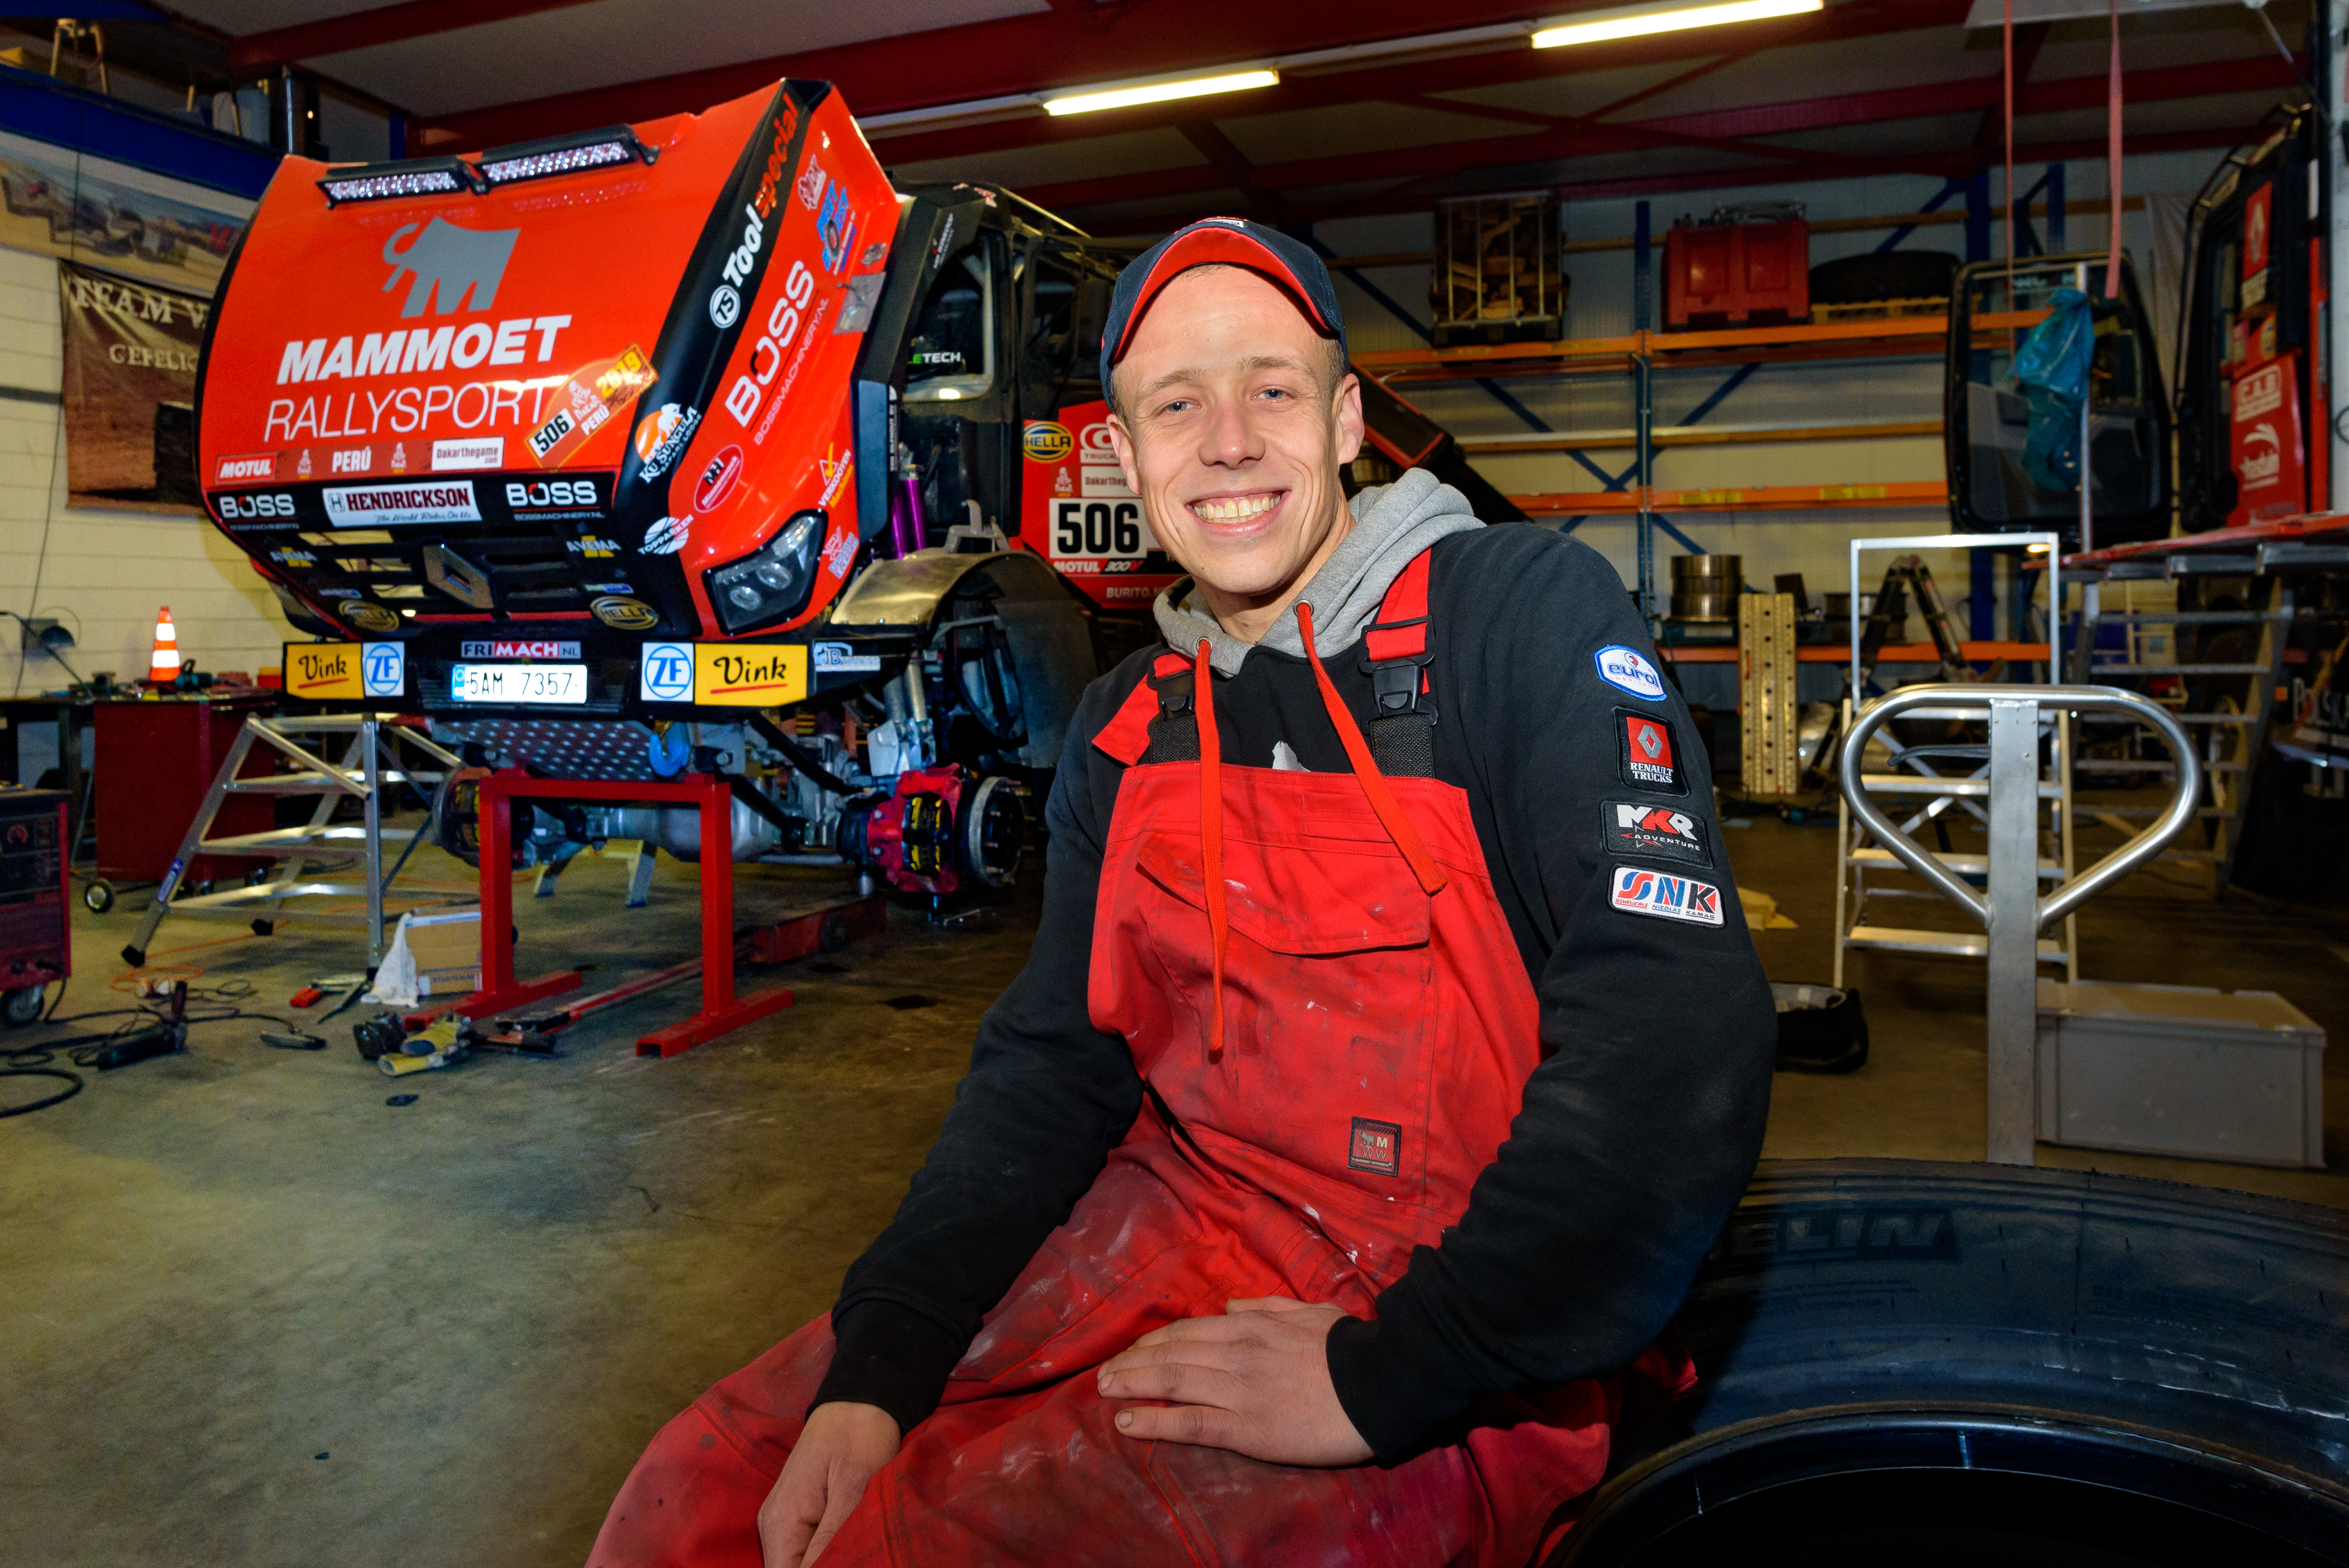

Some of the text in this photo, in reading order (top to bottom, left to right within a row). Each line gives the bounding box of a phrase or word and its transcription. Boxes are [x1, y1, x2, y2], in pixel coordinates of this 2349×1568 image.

[277, 314, 572, 386] MAMMOET
[725, 260, 814, 427] BOSS
[263, 375, 570, 443] RALLYSPORT
[533, 414, 570, 453] 506
[1025, 436, 1071, 448] HELLA
[437, 446, 499, 459] Dakarthegame
[219, 459, 271, 479] MOTUL
[1085, 477, 1127, 486] Dakartheg
[219, 494, 296, 518] BOSS
[346, 488, 471, 512] HENDRICKSON
[506, 481, 598, 507] BOSS
[637, 514, 694, 555] TOPPARKEN
[1057, 503, 1140, 554] 506
[1053, 560, 1145, 573] MOTUL 300V
[298, 654, 347, 681] Vink
[366, 655, 400, 684] ZF
[647, 658, 689, 687] ZF
[714, 655, 788, 685] Vink
[1607, 663, 1661, 688] eurol
[470, 672, 503, 695] 5AM
[521, 672, 572, 695] 7357
[1630, 762, 1673, 776] RENAULT
[1632, 770, 1673, 784] TRUCKS
[1634, 834, 1700, 851] ADVENTURE
[1615, 899, 1648, 907] SCHEUERLE
[1652, 904, 1681, 913] NICOLAS
[1686, 910, 1715, 919] KAMAG
